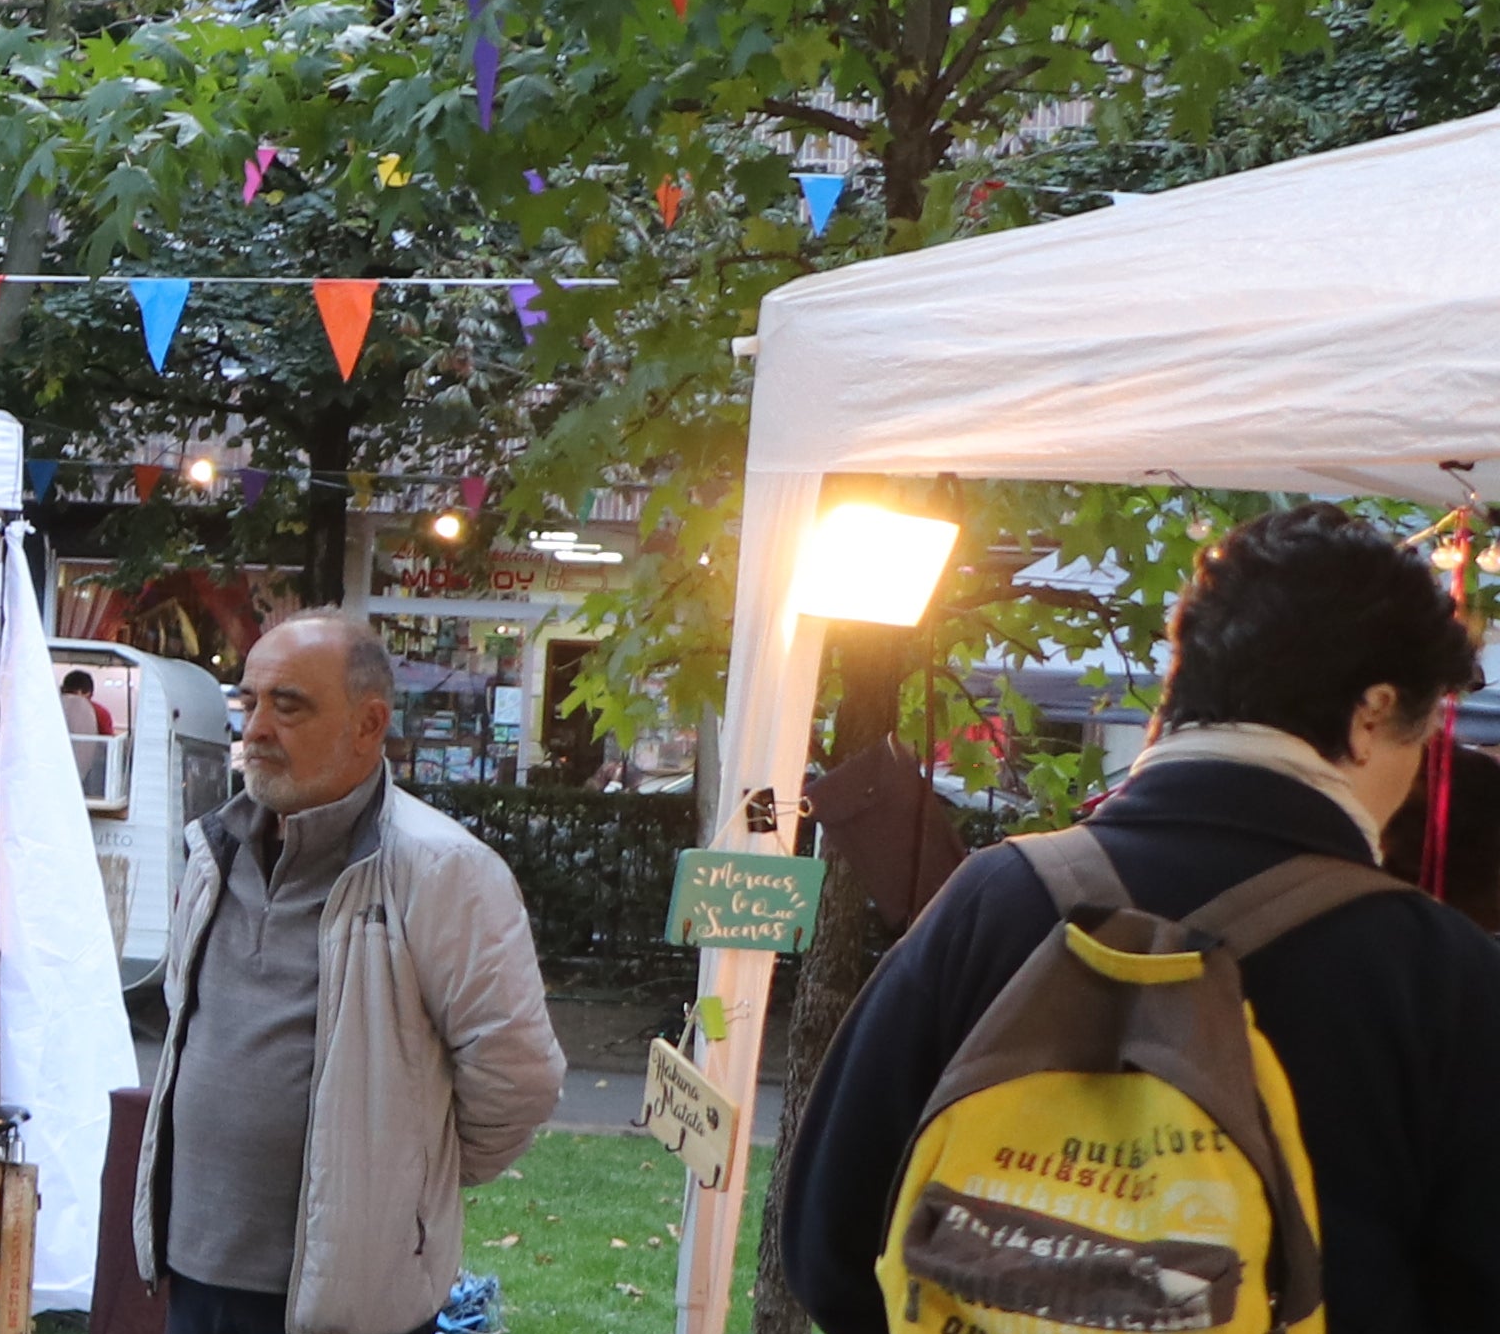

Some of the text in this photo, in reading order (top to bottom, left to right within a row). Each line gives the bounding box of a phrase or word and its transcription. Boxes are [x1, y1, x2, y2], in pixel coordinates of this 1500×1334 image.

[707, 861, 797, 893] Mereces
[652, 1047, 700, 1102] Hakuna
[654, 1083, 705, 1137] Matata
